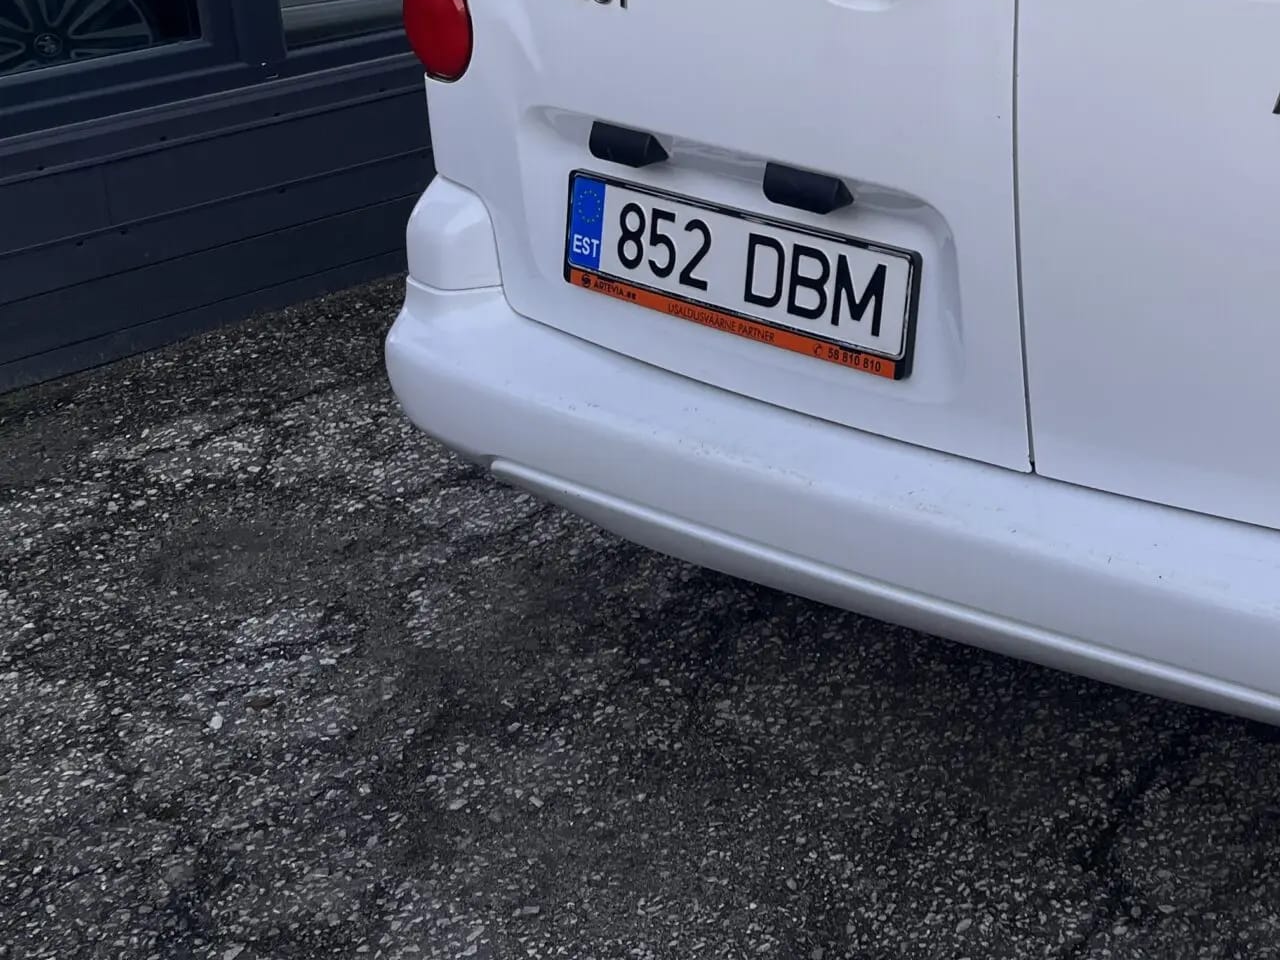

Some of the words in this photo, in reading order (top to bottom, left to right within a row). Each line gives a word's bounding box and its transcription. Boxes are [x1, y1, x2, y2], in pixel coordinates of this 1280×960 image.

[573, 234, 600, 258] EST
[617, 202, 711, 291] 852
[744, 232, 887, 337] DBM
[738, 323, 775, 342] PARTNER
[863, 358, 881, 373] 810
